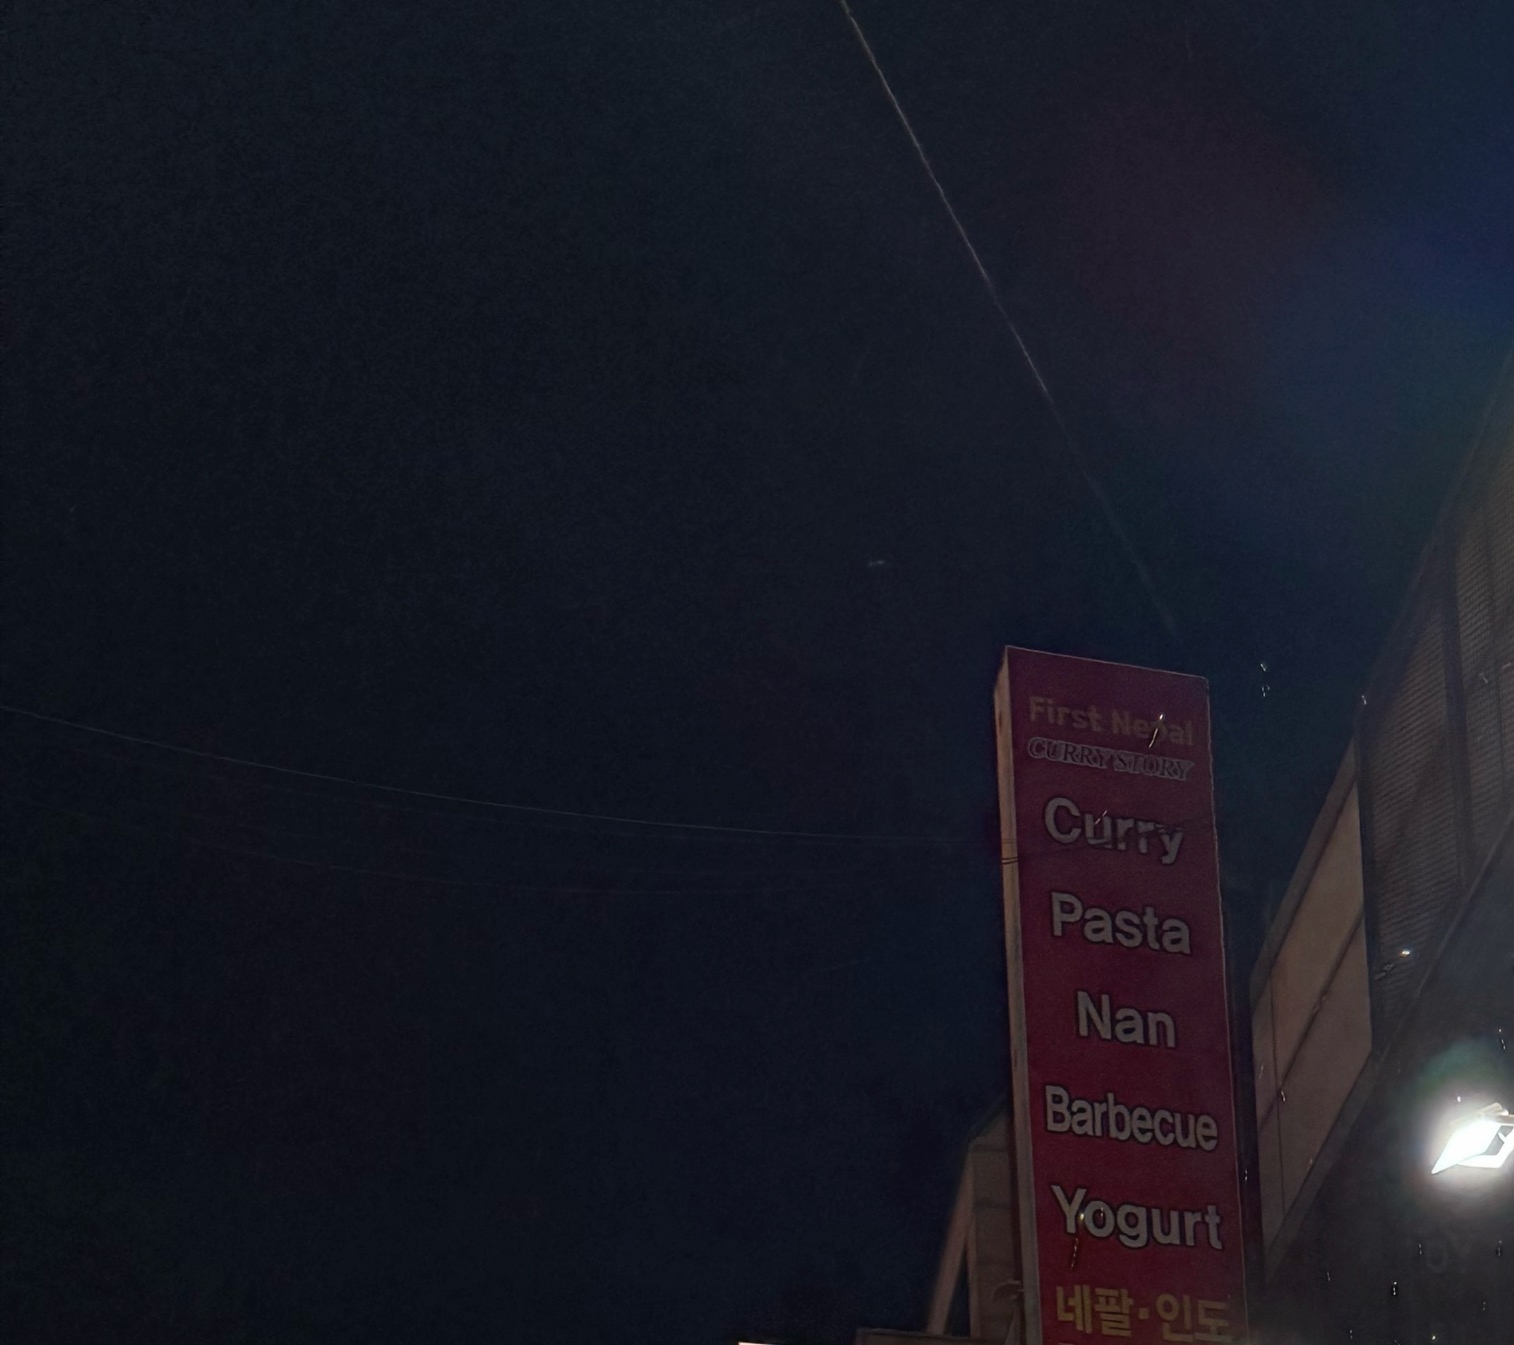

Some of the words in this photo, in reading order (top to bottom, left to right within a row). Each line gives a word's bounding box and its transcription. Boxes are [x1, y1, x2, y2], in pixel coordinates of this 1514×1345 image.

[1028, 695, 1102, 733] First
[1111, 708, 1194, 746] Nepal
[1027, 736, 1112, 769] CURRY
[1112, 750, 1195, 782] STORY
[1044, 796, 1184, 865] Curry
[1050, 891, 1192, 955] Pasta
[1077, 990, 1175, 1049] Nan
[1044, 1084, 1219, 1153] Barbecue
[1050, 1184, 1223, 1252] Yogurt
